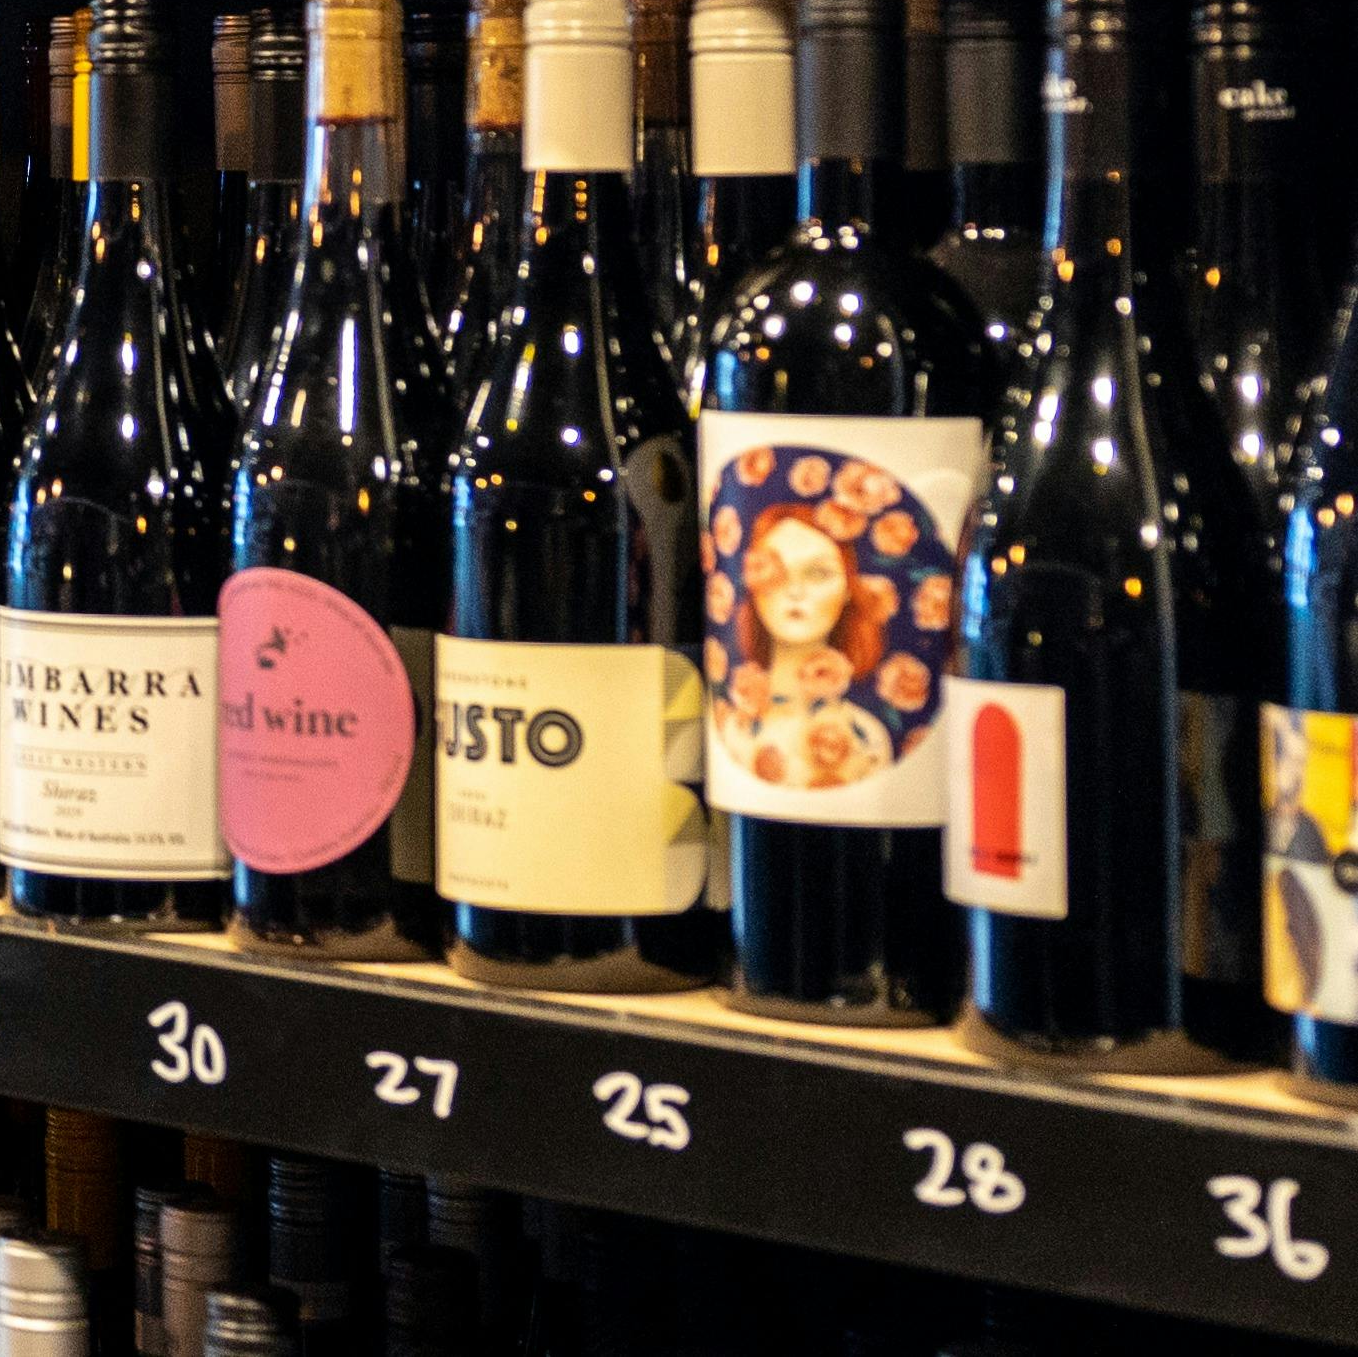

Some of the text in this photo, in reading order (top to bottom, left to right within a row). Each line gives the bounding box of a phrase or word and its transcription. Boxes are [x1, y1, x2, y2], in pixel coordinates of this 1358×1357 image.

[11, 697, 150, 735] WINES
[259, 700, 360, 738] wine
[42, 779, 98, 804] Shiraz
[147, 1000, 226, 1085] 30
[365, 1051, 460, 1119] 27
[592, 1072, 690, 1152] 25
[903, 1127, 1026, 1215] 28
[1206, 1174, 1330, 1282] 36
